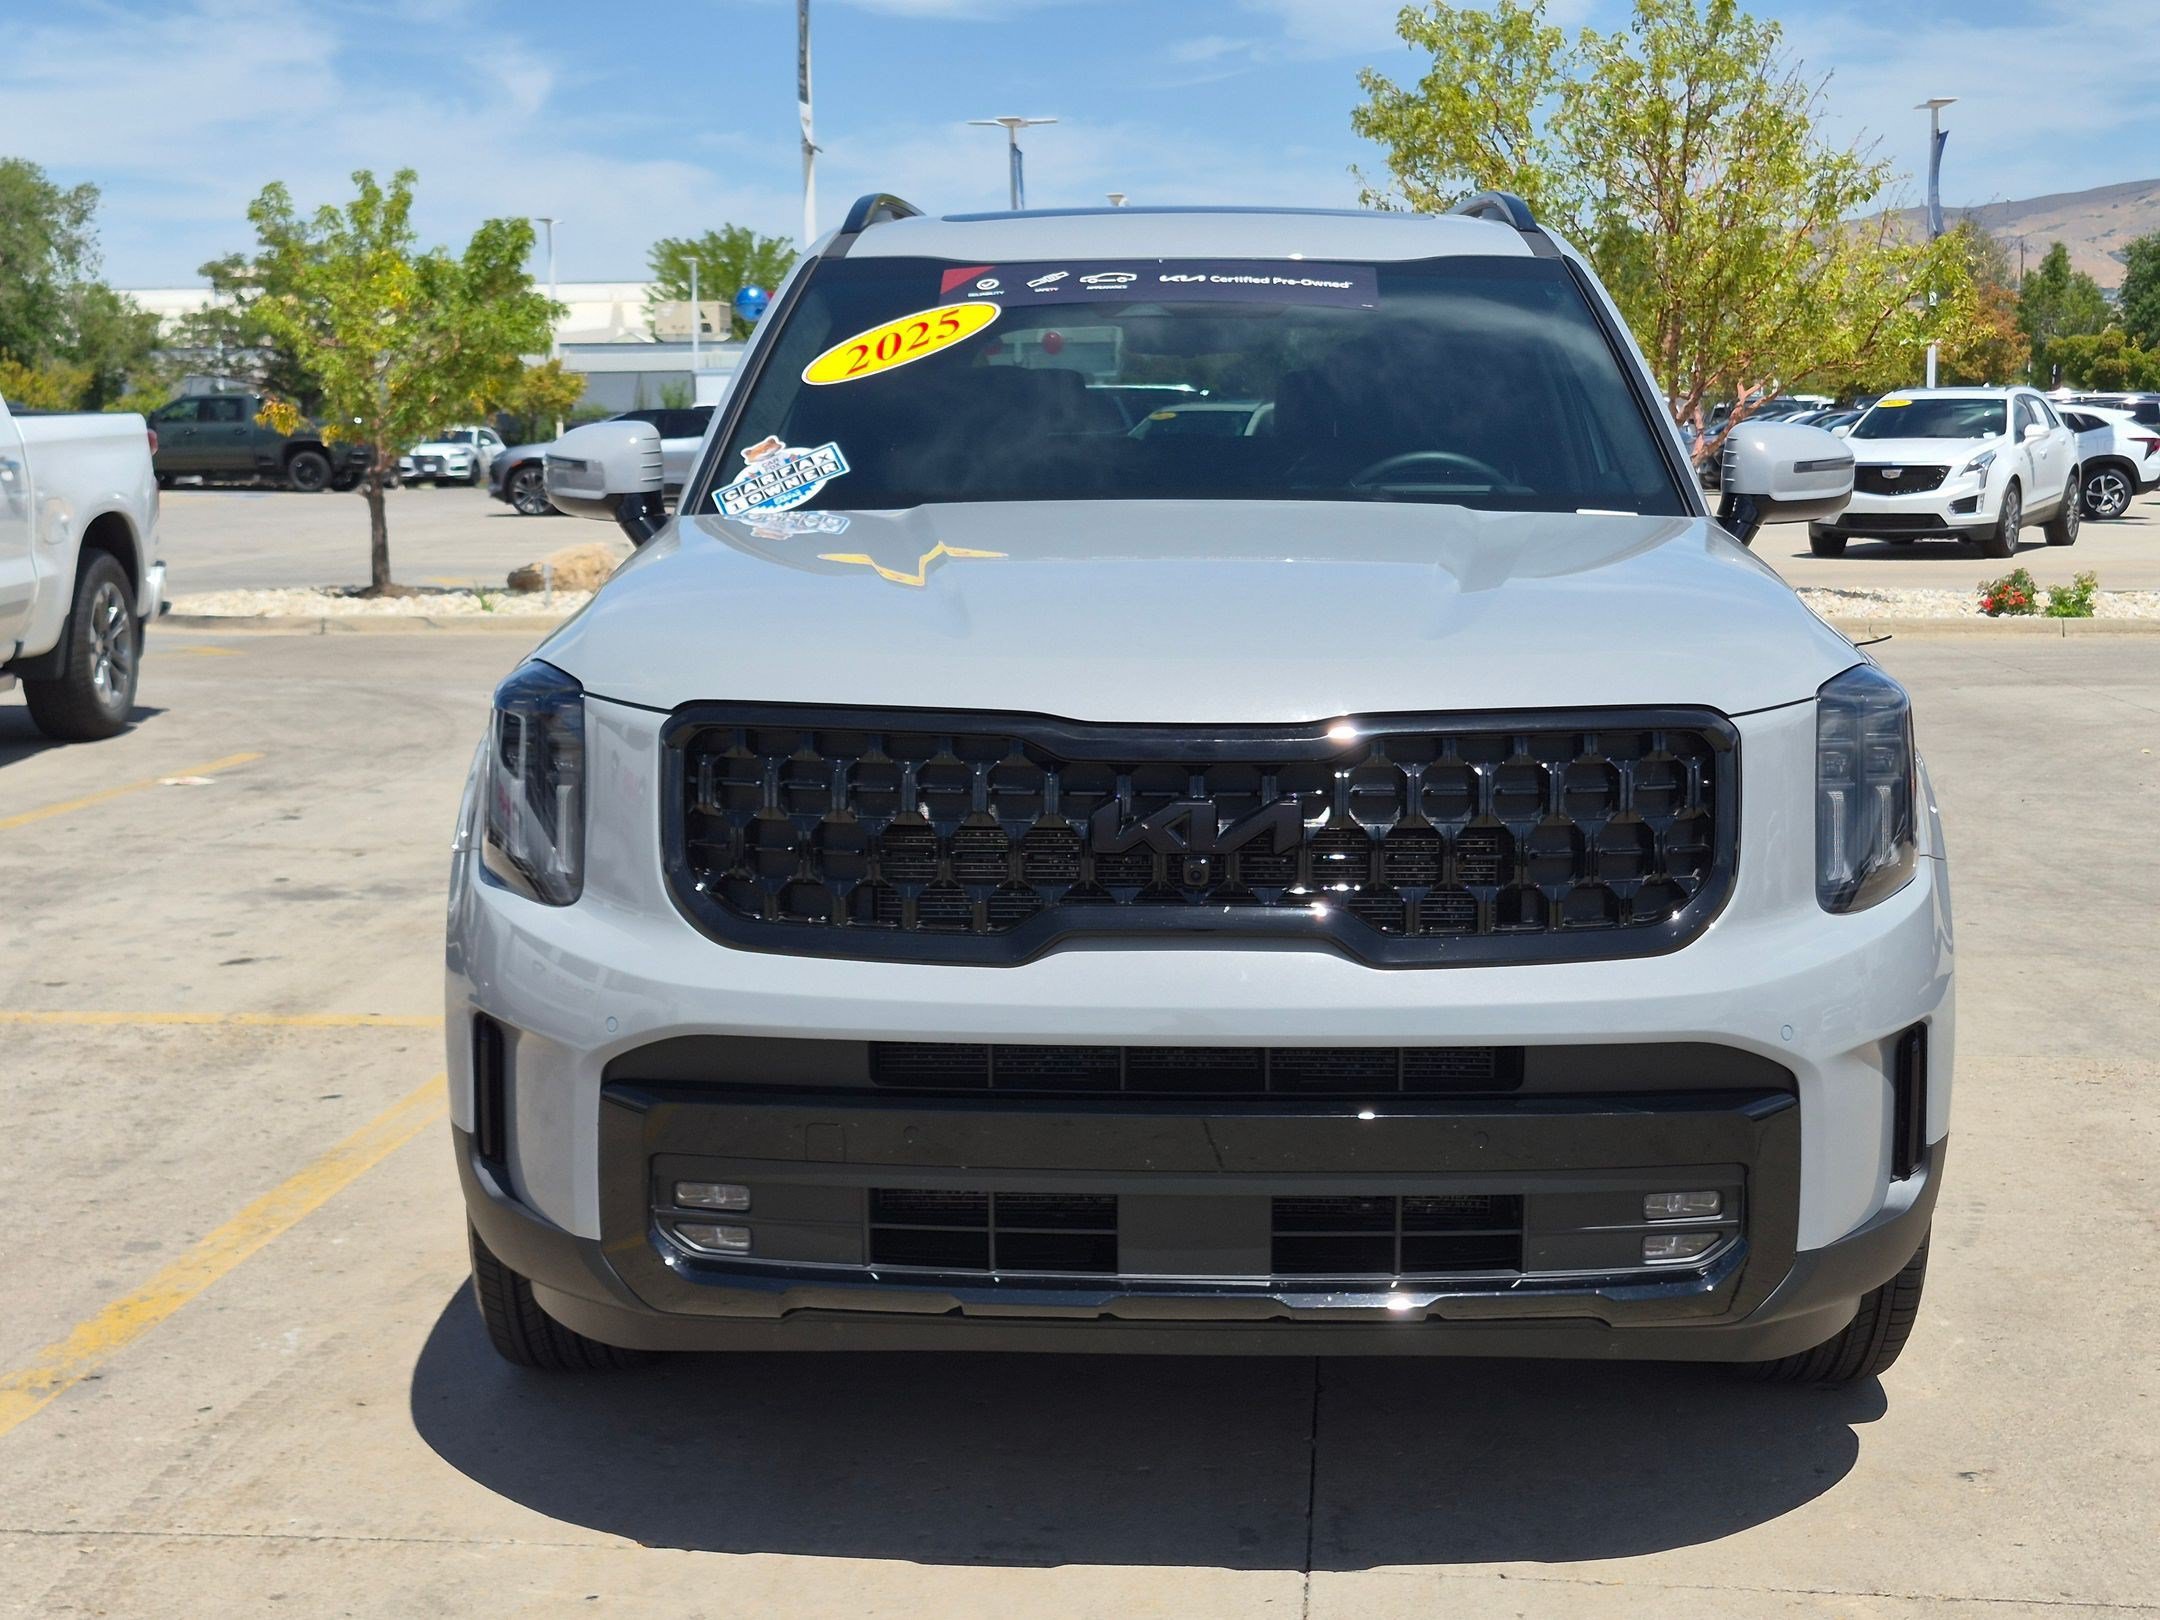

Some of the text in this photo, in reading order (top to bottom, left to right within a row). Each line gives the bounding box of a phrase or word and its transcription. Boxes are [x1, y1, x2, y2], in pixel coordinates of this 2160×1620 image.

[1209, 275, 1270, 284] Certified
[846, 309, 961, 376] 2025
[722, 452, 829, 503] CARFAX
[747, 461, 840, 506] OWNER
[1090, 795, 1303, 855] KIA
